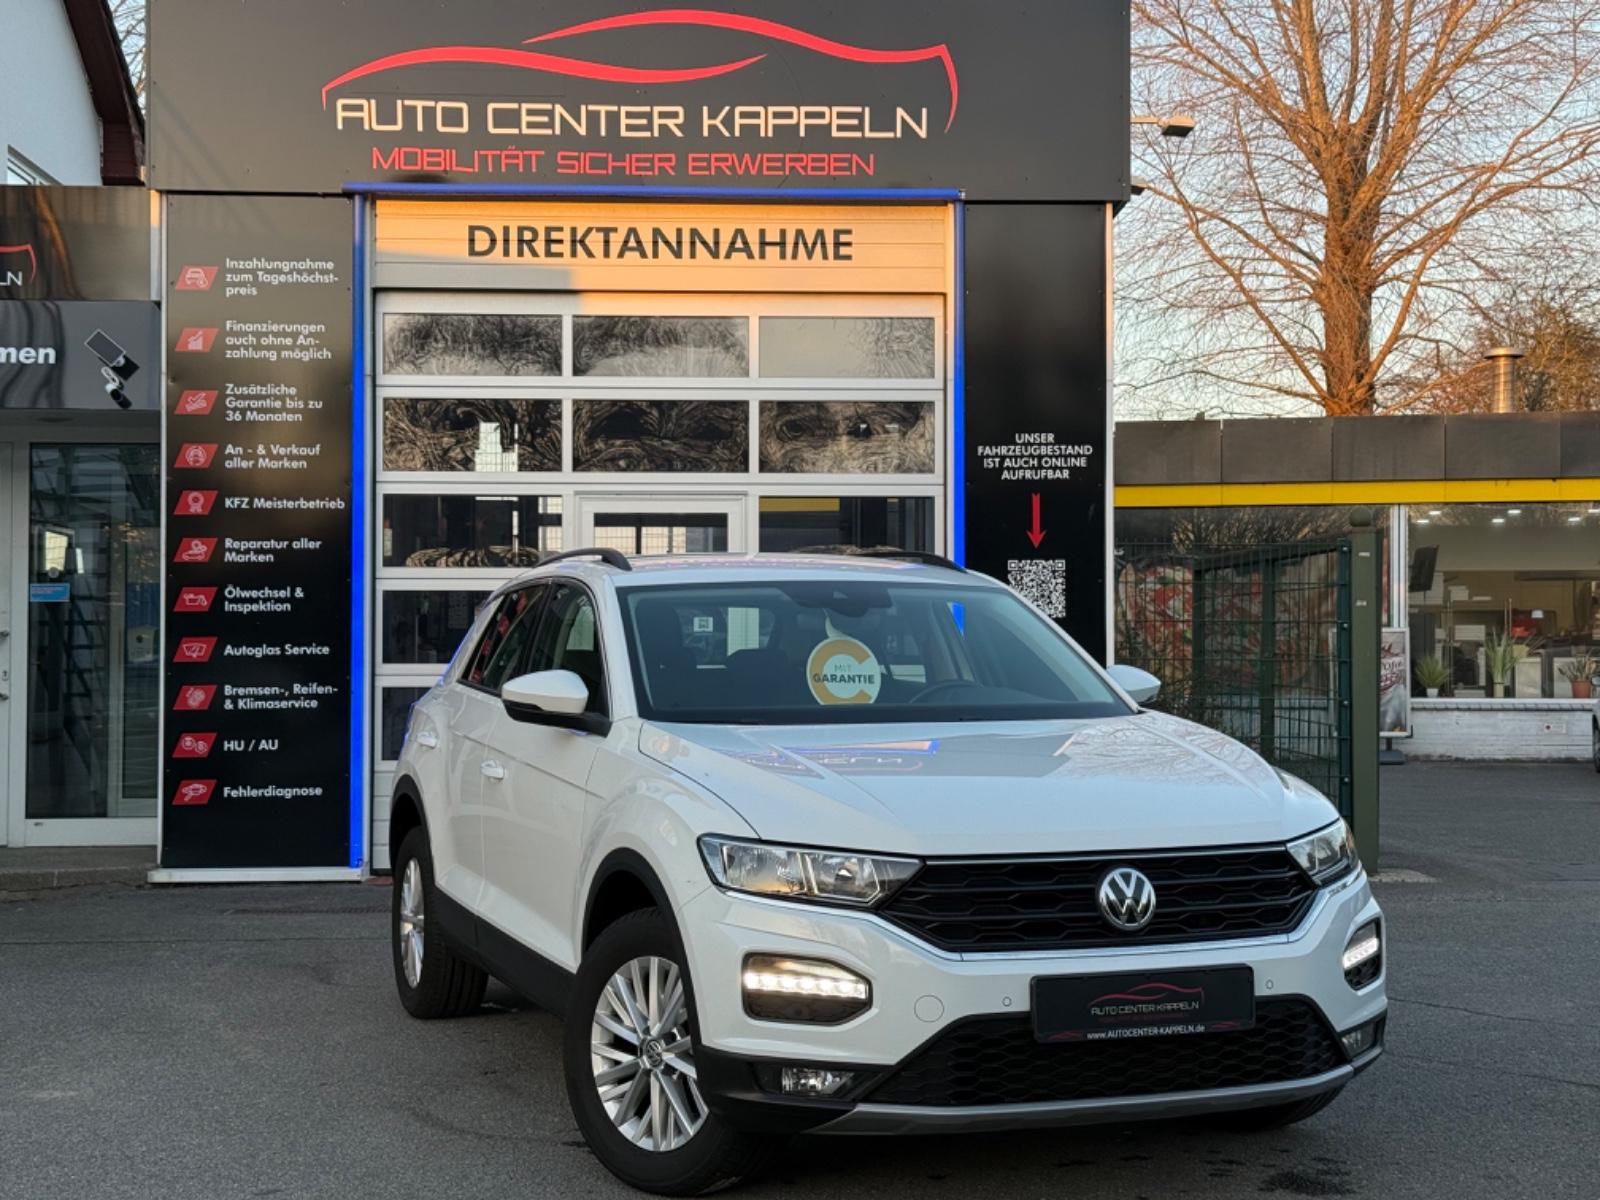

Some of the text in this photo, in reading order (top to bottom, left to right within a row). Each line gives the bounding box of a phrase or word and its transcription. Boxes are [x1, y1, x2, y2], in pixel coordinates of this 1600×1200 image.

[336, 98, 928, 139] AUTO CENTER KAPPELN
[372, 145, 875, 177] MOBILITÄT SICHER ERWERBEN
[467, 224, 853, 262] DIREKTANNAHME
[225, 258, 335, 272] Inzahlungnahme
[225, 271, 339, 284] zum Tageshöchst-
[225, 285, 258, 298] preis
[225, 320, 325, 335] Finanzierungen
[225, 334, 320, 345] auch ohne An-
[225, 348, 332, 361] zahlung möglich
[225, 383, 297, 395] Zusätzliche
[225, 396, 323, 409] Garantie bis zu
[225, 410, 303, 421] 36 Monaten
[1015, 432, 1055, 444] UNSER
[224, 443, 243, 455] An
[257, 444, 266, 455] &
[270, 443, 321, 455] Verkauf
[977, 445, 1093, 456] FAHRZEUGBESTAND
[224, 457, 307, 469] aller Marken
[983, 457, 1088, 469] IST AUCH ONLINE
[1001, 469, 1070, 480] AUFRUFBAR
[224, 497, 345, 509] KFZ Meisterbetrieb
[224, 537, 322, 551] Reparatur aller
[224, 551, 274, 563] Marken
[224, 584, 304, 598] Ölwechsel &
[224, 600, 291, 613] Inspektion
[224, 643, 330, 657] Autoglas Service
[834, 664, 852, 673] MIT
[812, 672, 875, 684] GARANTIE
[224, 683, 339, 697] Bremsen-, Reifen-
[224, 697, 318, 710] & Klimaservice
[223, 739, 279, 752] HU / AU
[223, 785, 323, 799] Fehlerdiagnose
[1099, 867, 1156, 931] VW
[1091, 1001, 1200, 1016] AUTO CENTER KAPPELN
[1087, 1023, 1206, 1040] www.AUTOCENTER-KAPPELN.de
